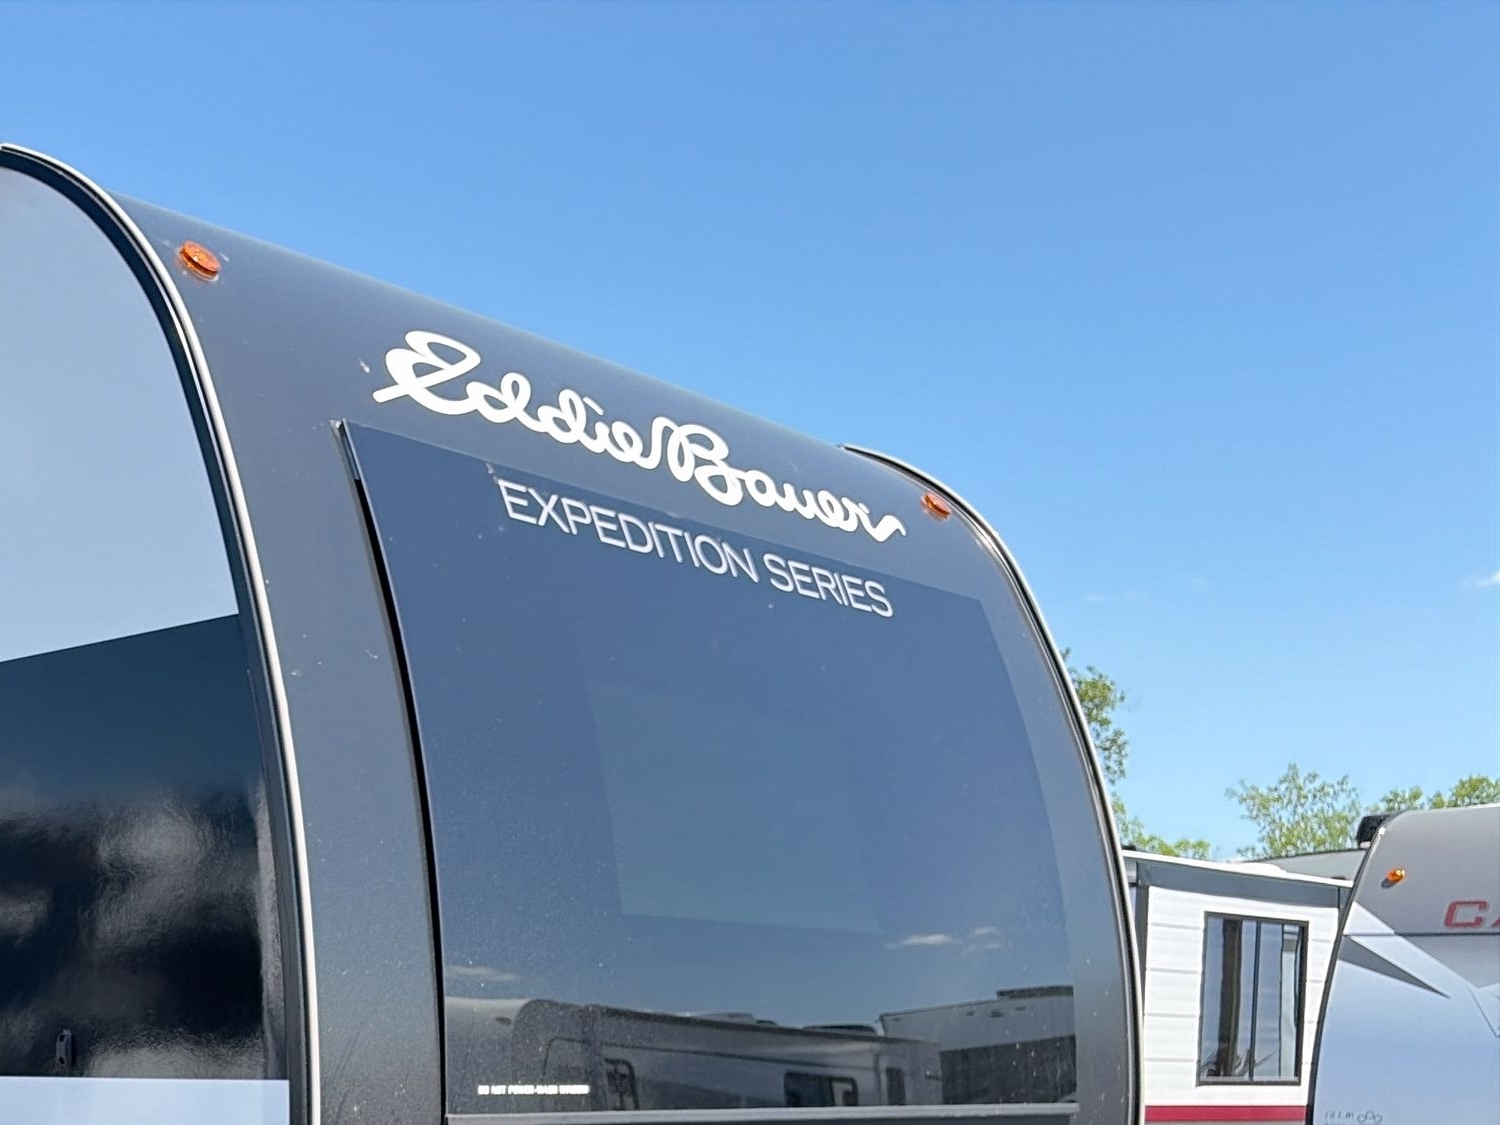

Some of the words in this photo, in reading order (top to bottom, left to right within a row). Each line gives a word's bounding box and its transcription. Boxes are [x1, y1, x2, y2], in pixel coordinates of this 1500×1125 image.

[372, 330, 654, 471] Eddie
[648, 416, 906, 543] Bauer
[498, 478, 759, 583] EXPEDITION
[762, 552, 894, 618] SERIES
